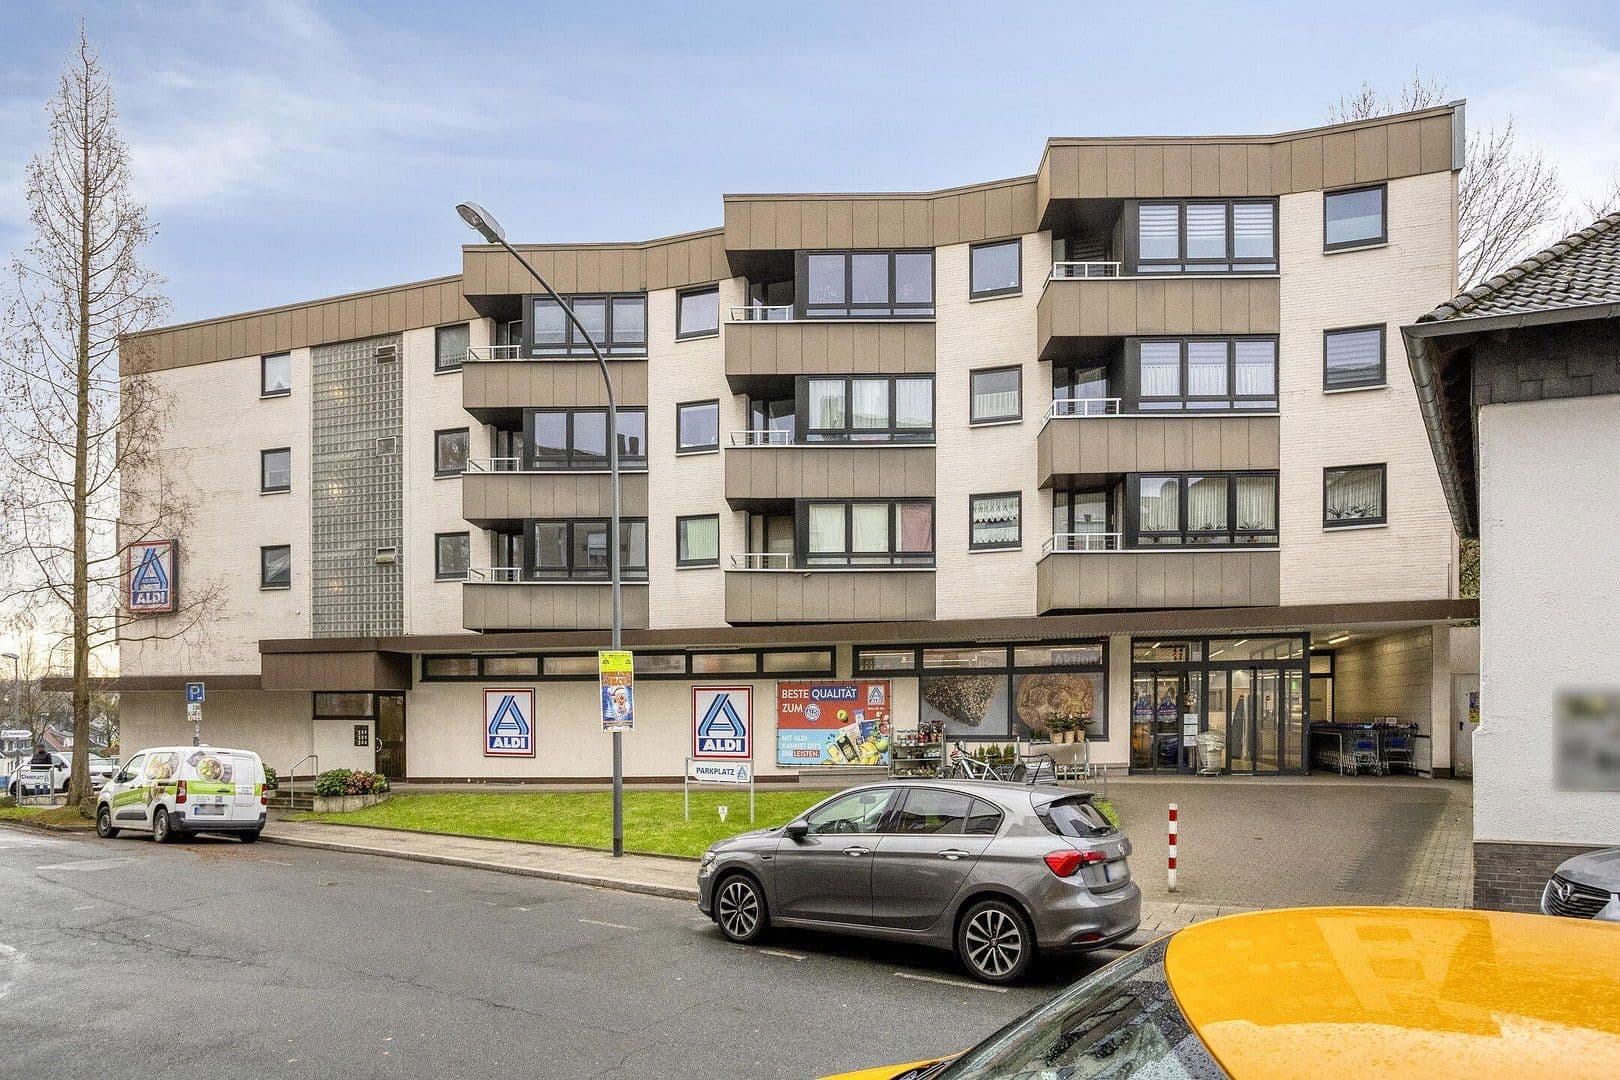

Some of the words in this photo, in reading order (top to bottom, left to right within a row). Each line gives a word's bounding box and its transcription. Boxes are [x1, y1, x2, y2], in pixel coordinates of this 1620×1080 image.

[136, 591, 165, 605] ALDI
[782, 689, 809, 699] BESTE
[812, 686, 857, 700] QUALITÄT
[782, 704, 803, 713] ZUM
[492, 736, 526, 749] ALDI
[702, 739, 742, 752] ALDI
[696, 767, 735, 776] PARKPLATZ
